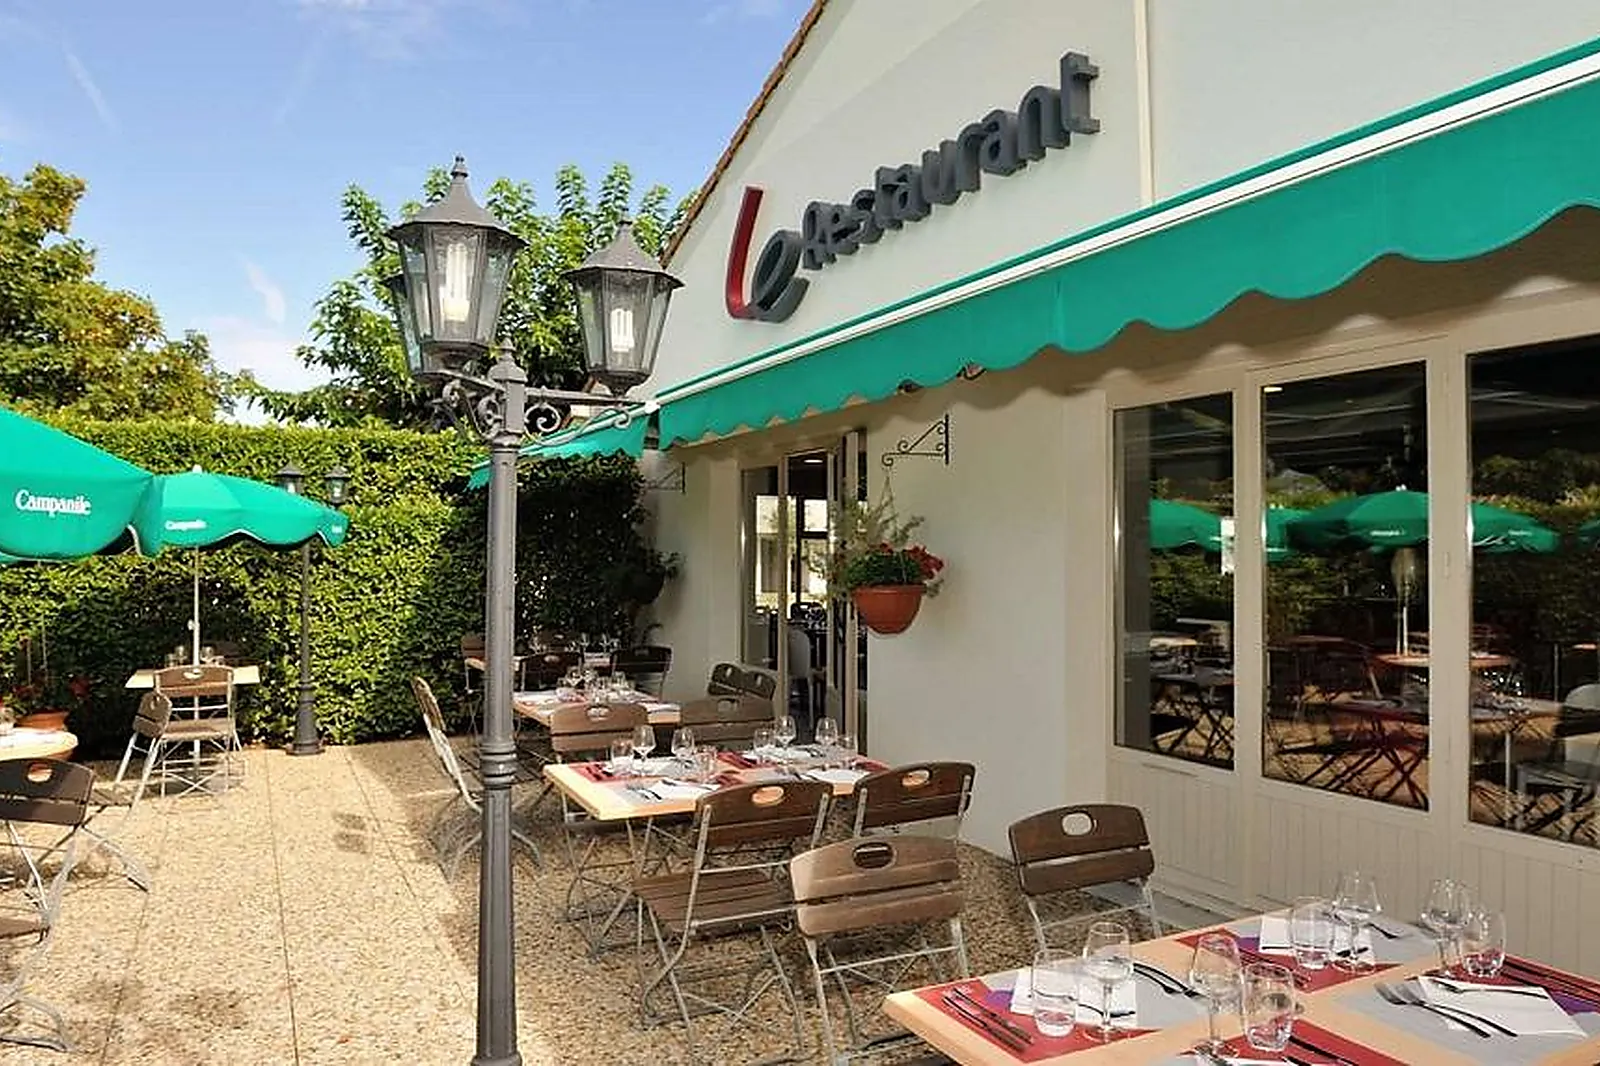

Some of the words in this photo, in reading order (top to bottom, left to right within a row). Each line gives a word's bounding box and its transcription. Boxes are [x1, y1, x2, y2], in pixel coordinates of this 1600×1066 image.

[726, 187, 809, 322] Le
[802, 52, 1100, 270] Restaurant
[15, 489, 92, 518] Campanile
